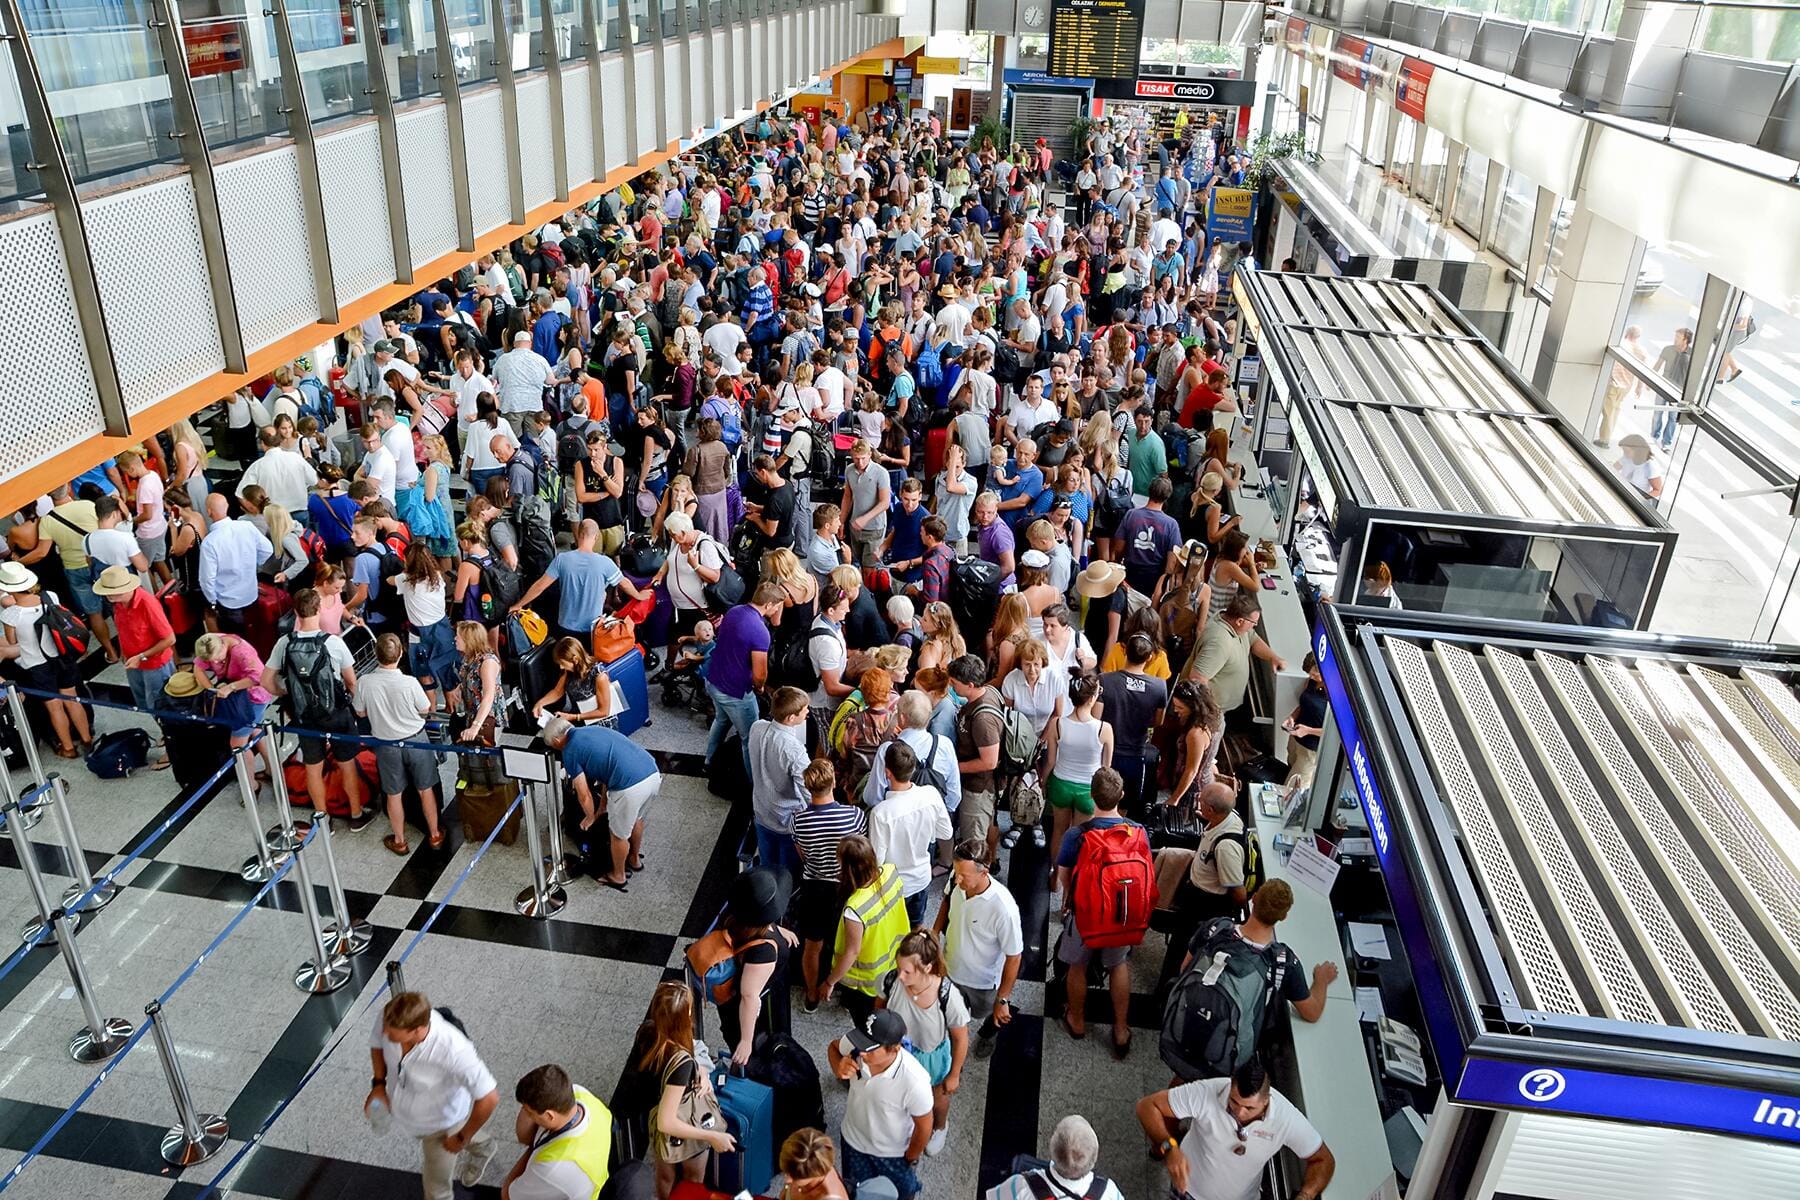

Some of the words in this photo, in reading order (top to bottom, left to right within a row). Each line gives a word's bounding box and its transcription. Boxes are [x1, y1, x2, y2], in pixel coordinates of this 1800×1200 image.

[1141, 83, 1170, 94] TISAK
[1177, 85, 1209, 96] media
[1215, 195, 1252, 204] INSURED
[1353, 740, 1389, 855] Information
